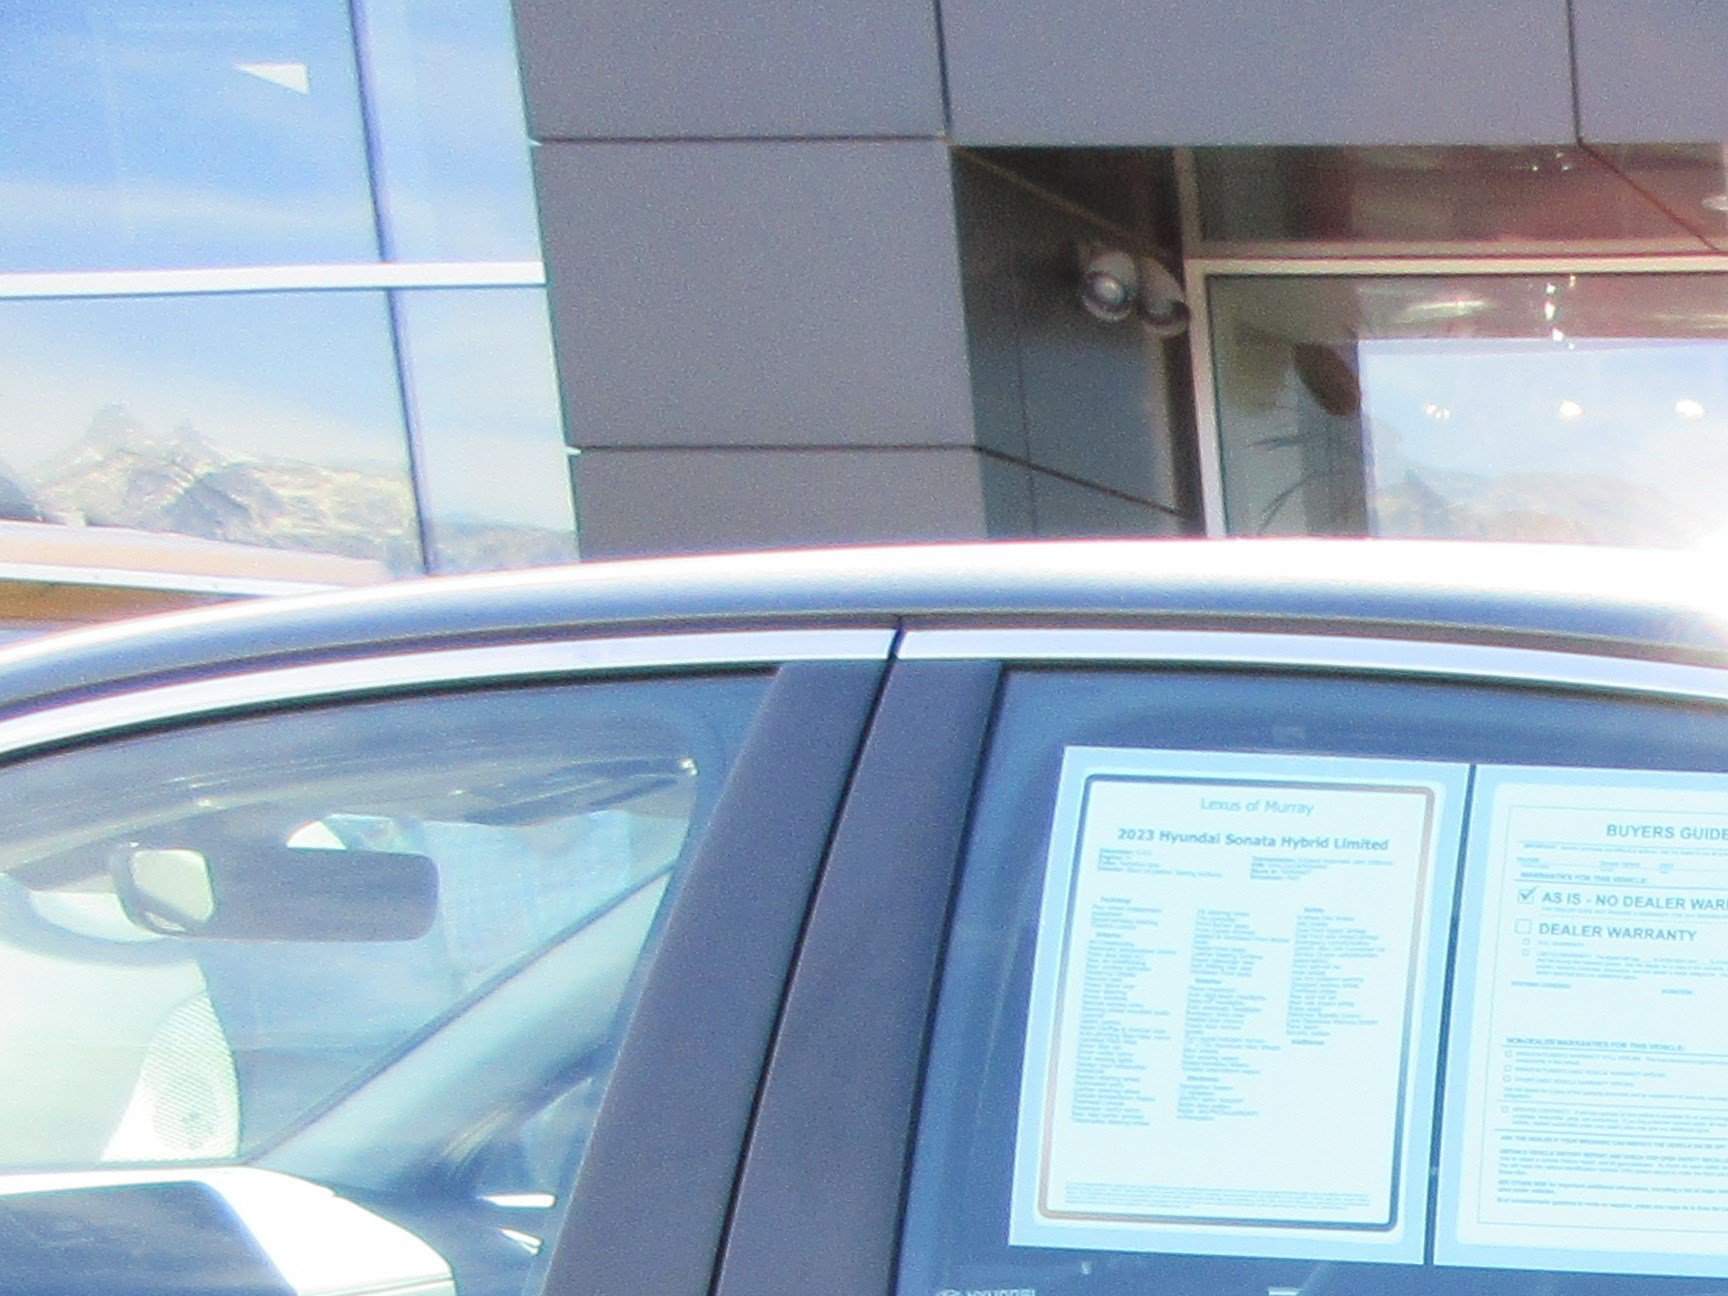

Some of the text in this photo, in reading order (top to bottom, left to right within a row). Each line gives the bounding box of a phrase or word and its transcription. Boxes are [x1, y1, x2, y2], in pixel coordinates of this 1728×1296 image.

[1201, 797, 1314, 816] Lexus of Murray
[1118, 827, 1389, 851] 2023 Hyundai Sonata Hybrid Limited
[1606, 823, 1675, 840] BUYERS
[1541, 891, 1562, 905] AS
[1566, 892, 1582, 906] IS
[1595, 894, 1618, 908] NO
[1623, 895, 1686, 910] DEALER
[1538, 922, 1698, 942] DEALER WARRANTY
